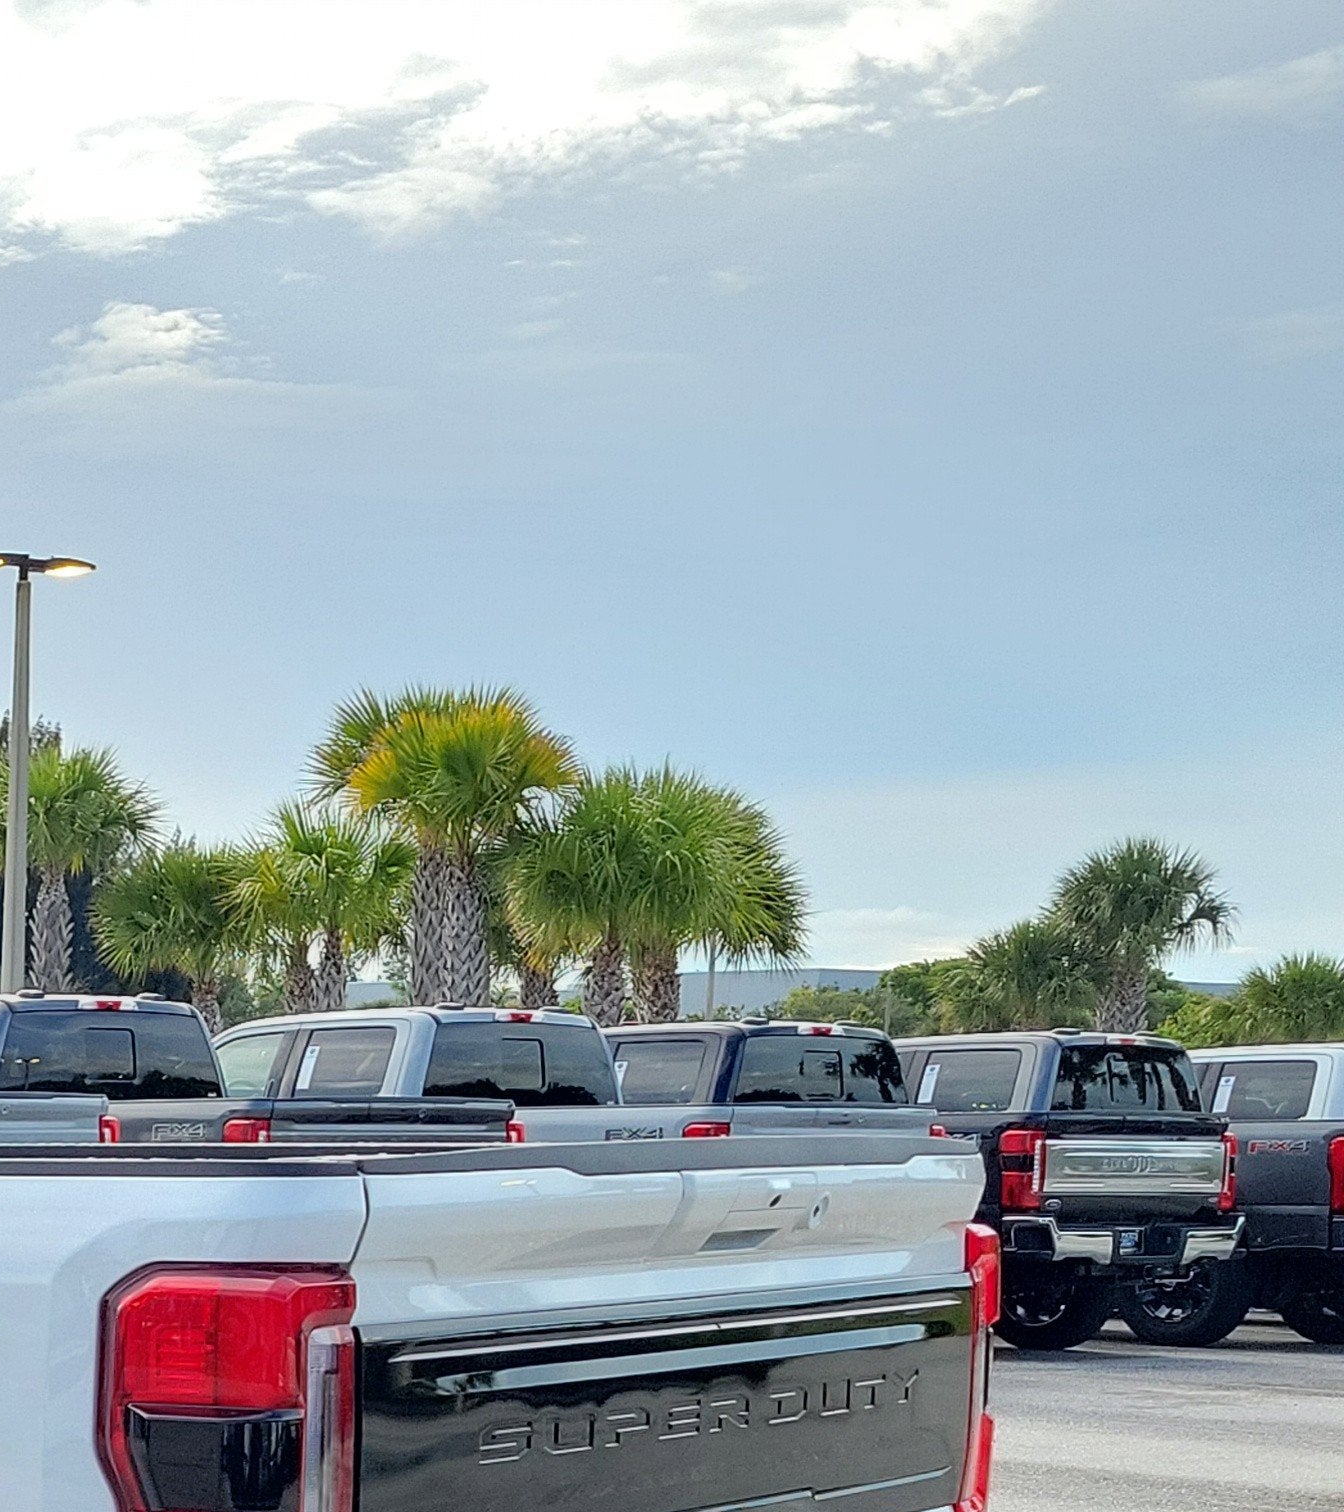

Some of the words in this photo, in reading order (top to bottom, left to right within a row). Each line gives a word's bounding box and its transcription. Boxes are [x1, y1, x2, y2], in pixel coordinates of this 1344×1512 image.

[152, 1123, 208, 1142] FX4
[604, 1126, 664, 1142] FX4
[1248, 1139, 1311, 1154] FX4
[478, 1396, 750, 1466] SUPER
[768, 1367, 920, 1427] DUTY
